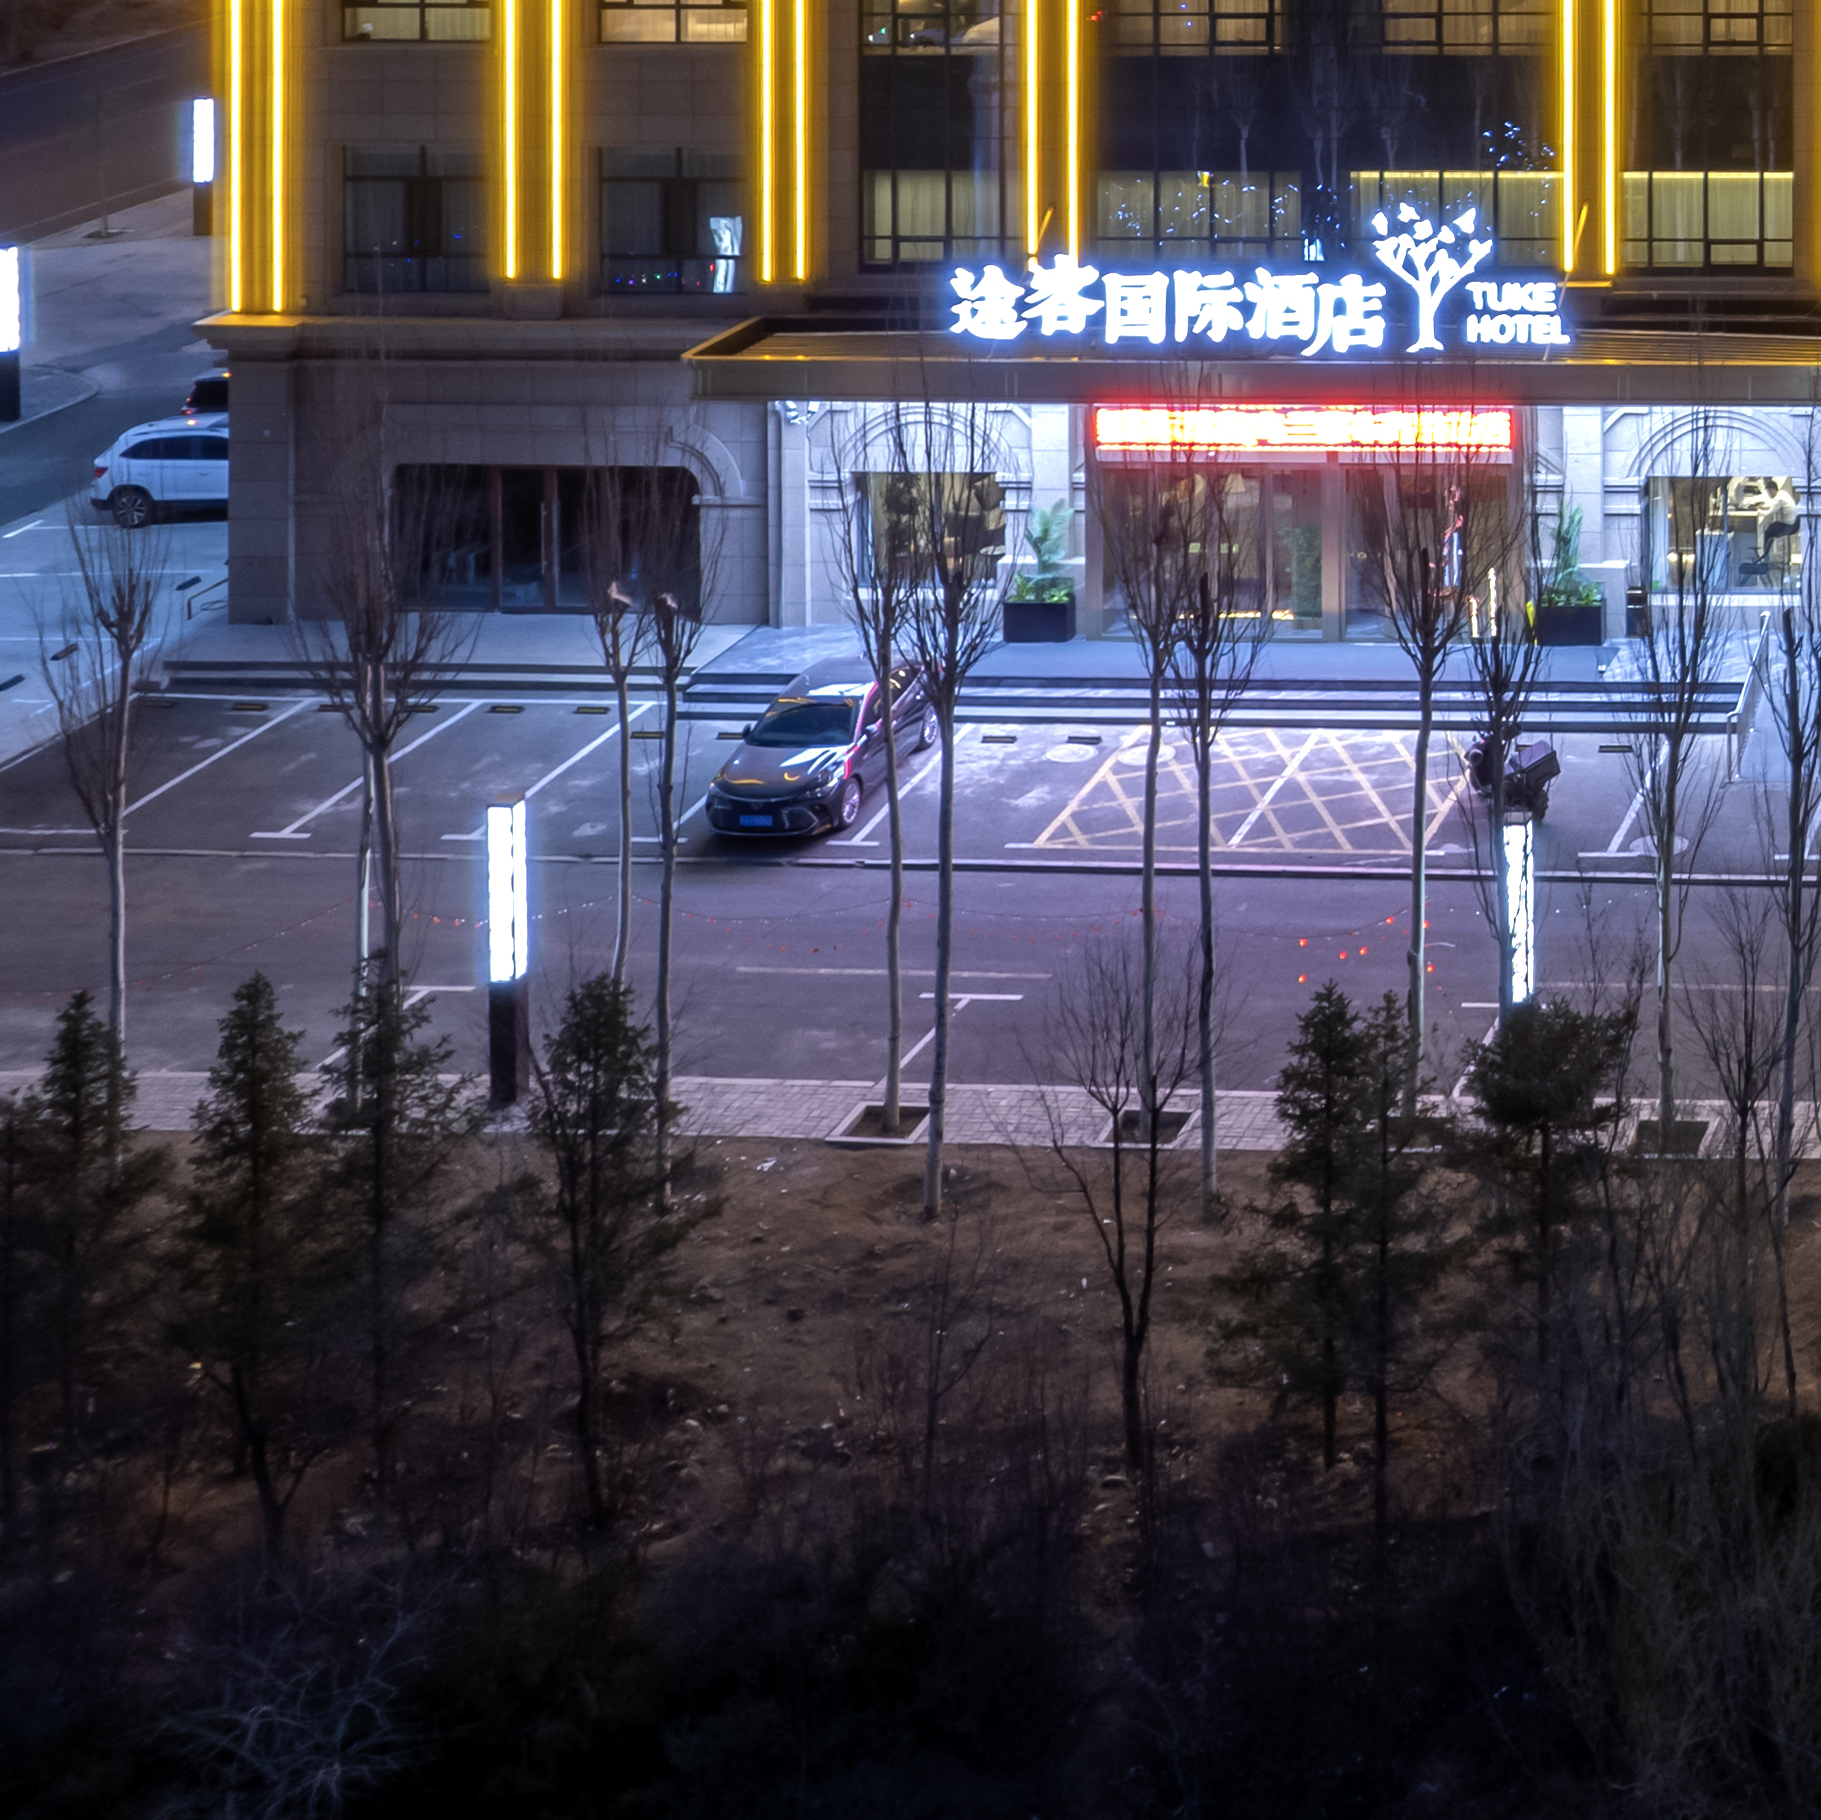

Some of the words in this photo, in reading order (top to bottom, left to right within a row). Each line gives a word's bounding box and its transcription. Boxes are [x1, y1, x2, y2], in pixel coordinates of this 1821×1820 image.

[949, 253, 1387, 357] 途客国际酒店
[1465, 281, 1557, 312] TUKE
[1466, 313, 1571, 344] HOTEL
